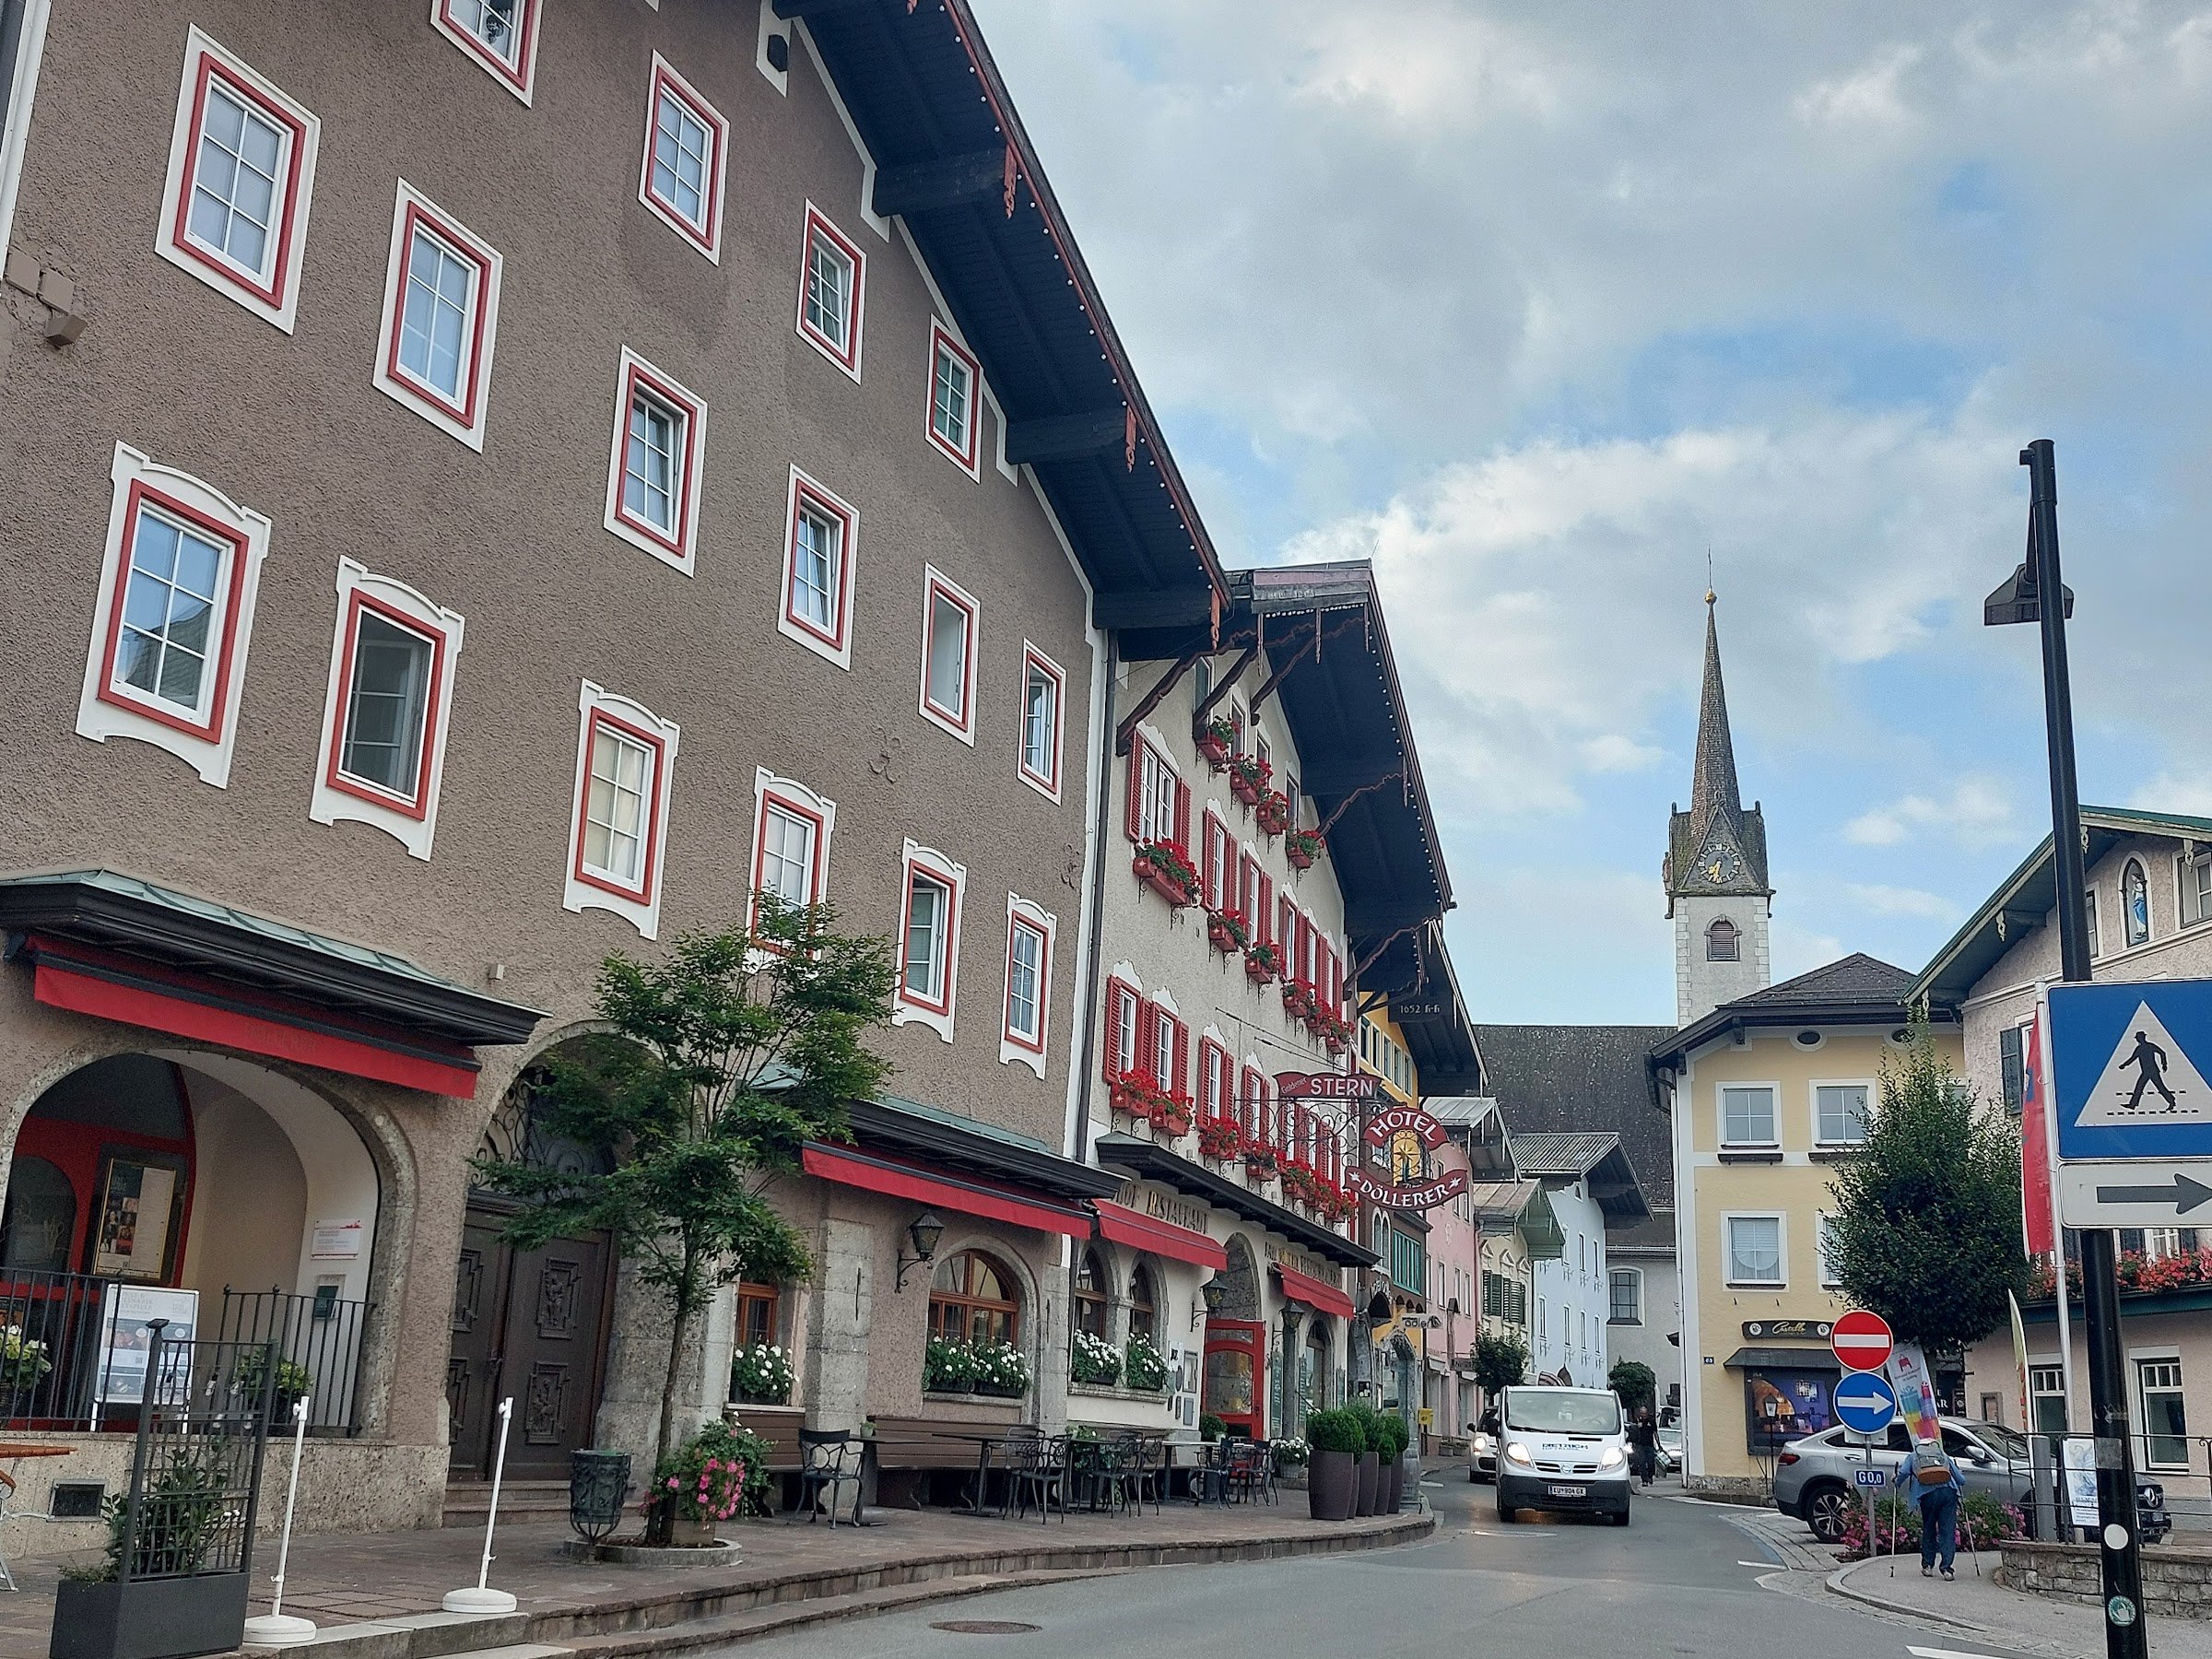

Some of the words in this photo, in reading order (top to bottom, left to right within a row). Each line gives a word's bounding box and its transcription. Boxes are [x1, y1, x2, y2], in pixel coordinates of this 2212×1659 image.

[1310, 1077, 1372, 1097] STERN
[1370, 1111, 1437, 1142] HOTEL
[1359, 1180, 1449, 1207] DÖLLERER
